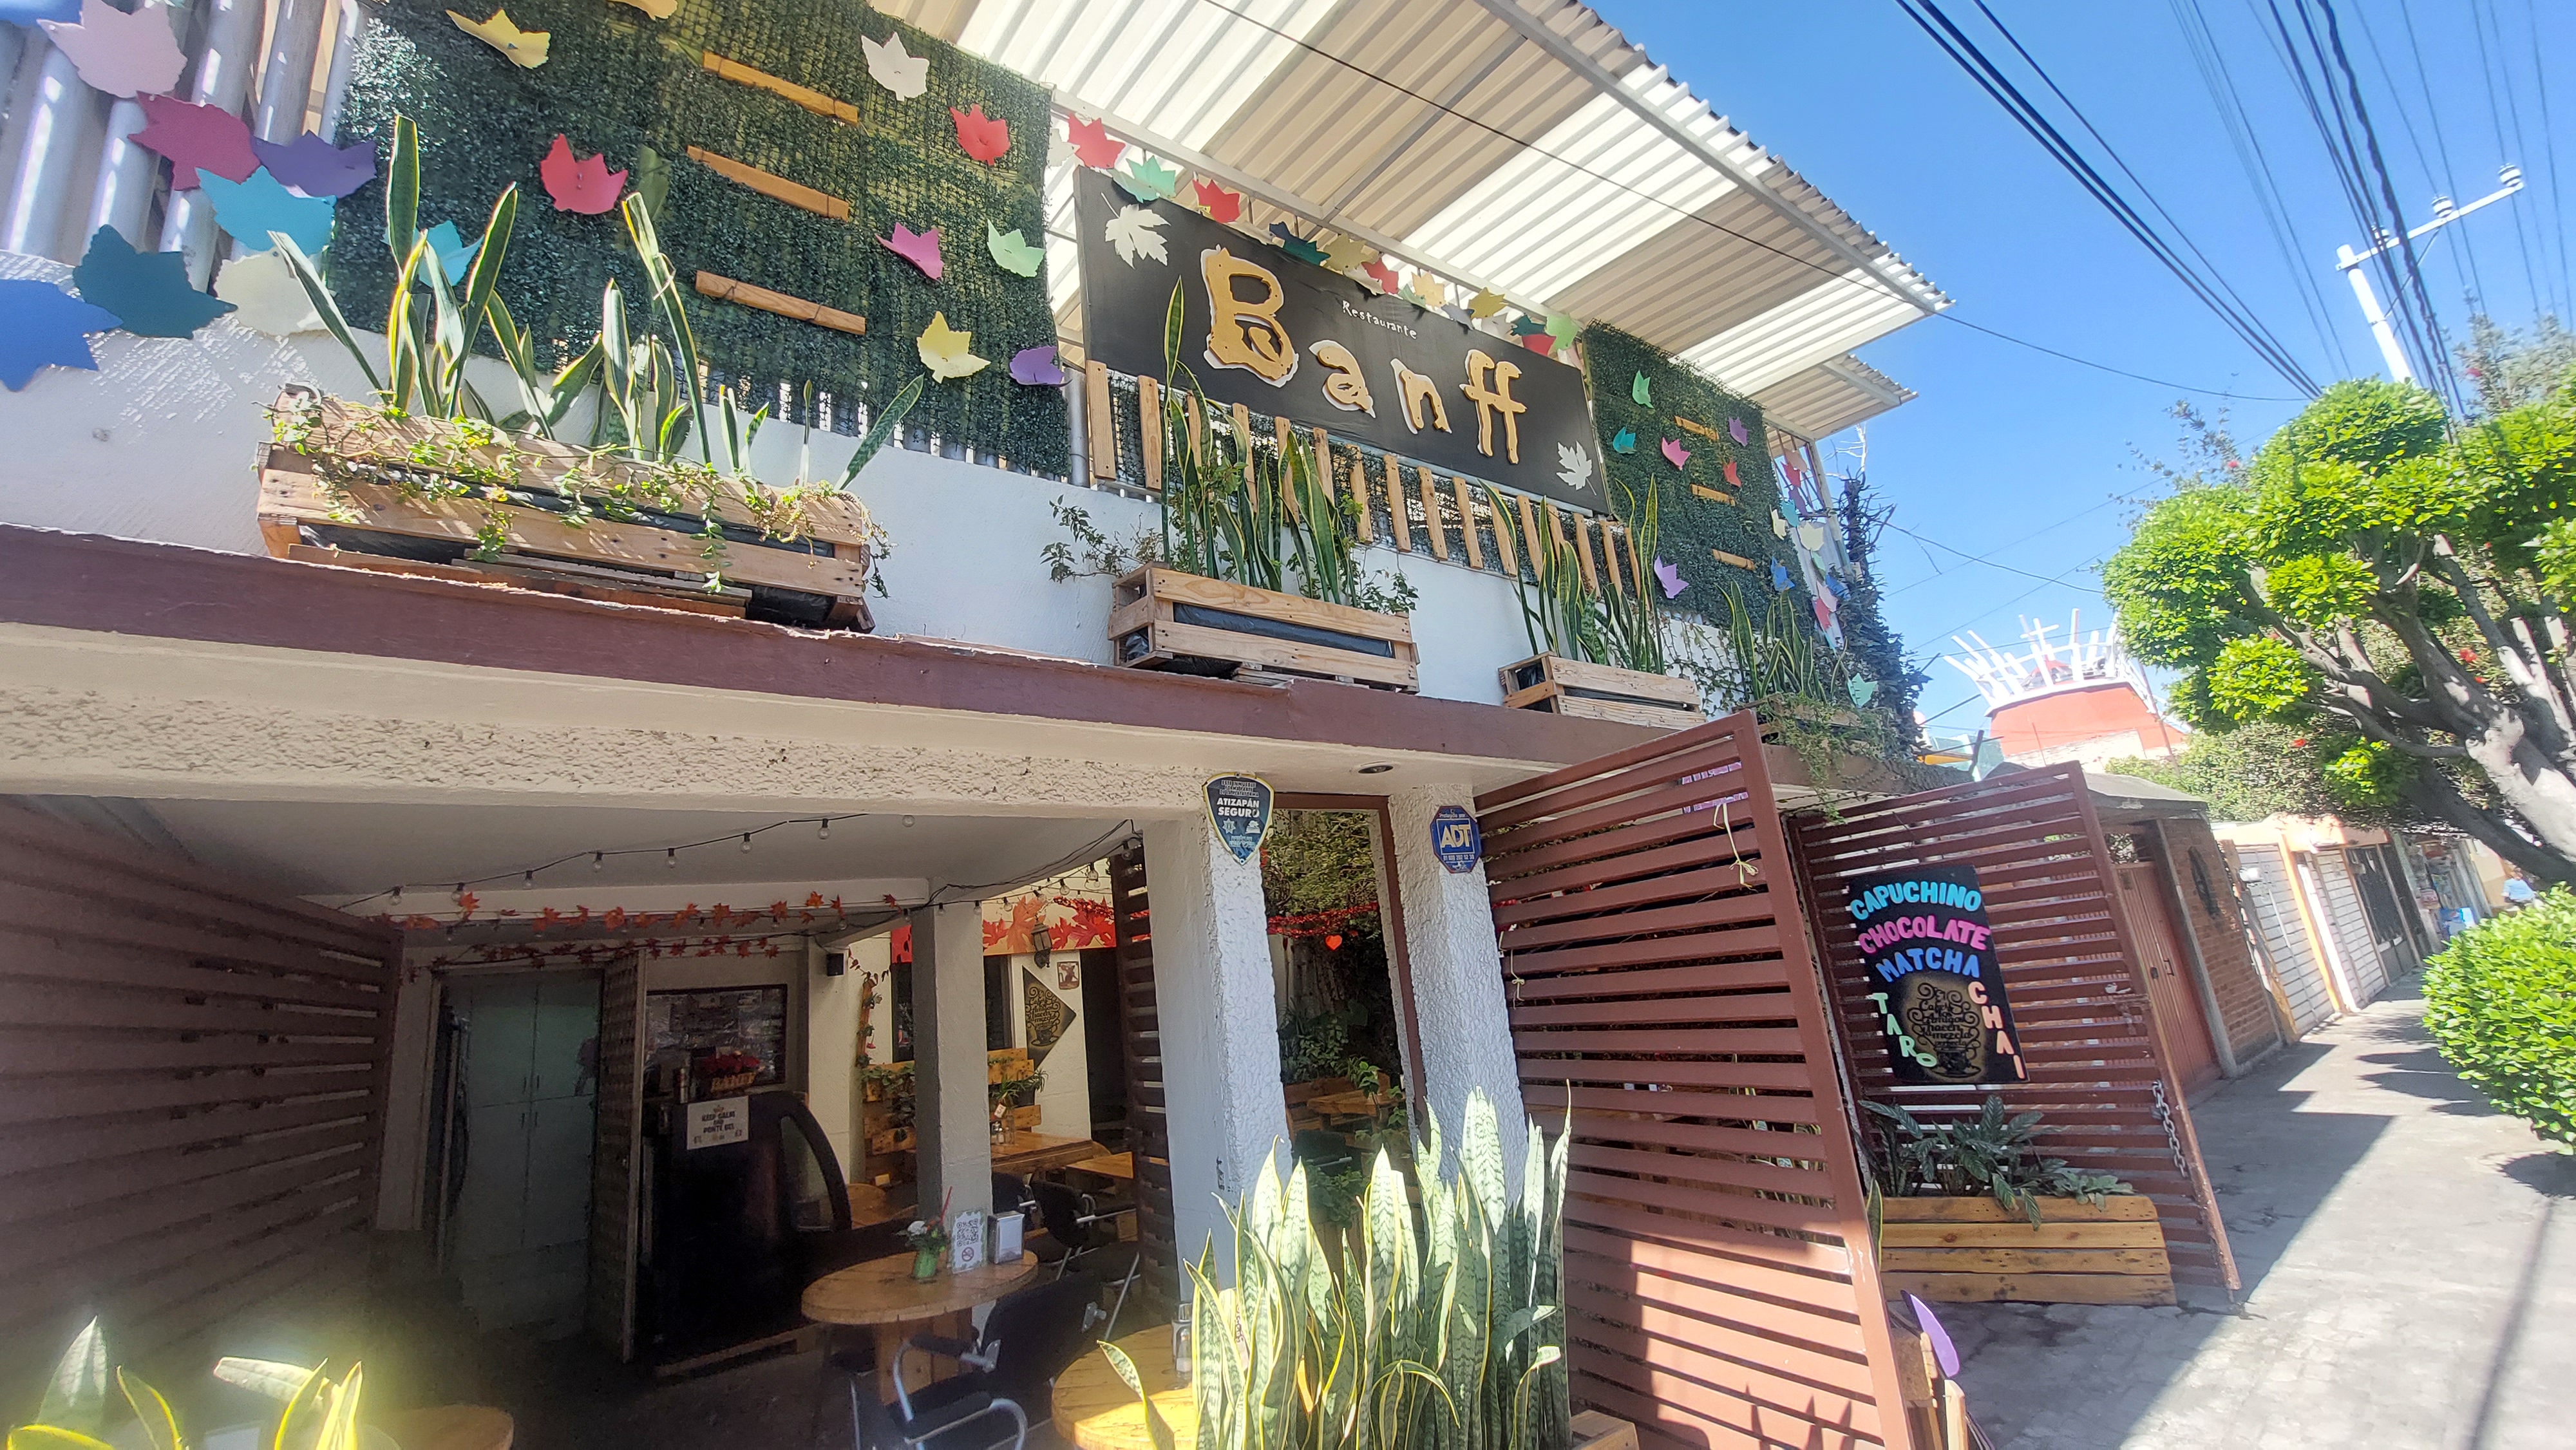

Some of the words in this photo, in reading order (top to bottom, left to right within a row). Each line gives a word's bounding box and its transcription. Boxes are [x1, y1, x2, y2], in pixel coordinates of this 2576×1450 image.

[1341, 300, 1417, 340] Restaurante
[1200, 245, 1527, 464] Banff
[1217, 798, 1260, 807] ATIZAPÁN
[1218, 807, 1260, 818] SEGURO
[1441, 825, 1470, 848] ADT
[1850, 881, 1981, 920] CAPUCHINO
[1859, 915, 1991, 954] CHOCOLATE
[1875, 946, 1979, 983] MATCHA
[1873, 992, 1937, 1068] TARO
[1968, 981, 2025, 1079] CHAI
